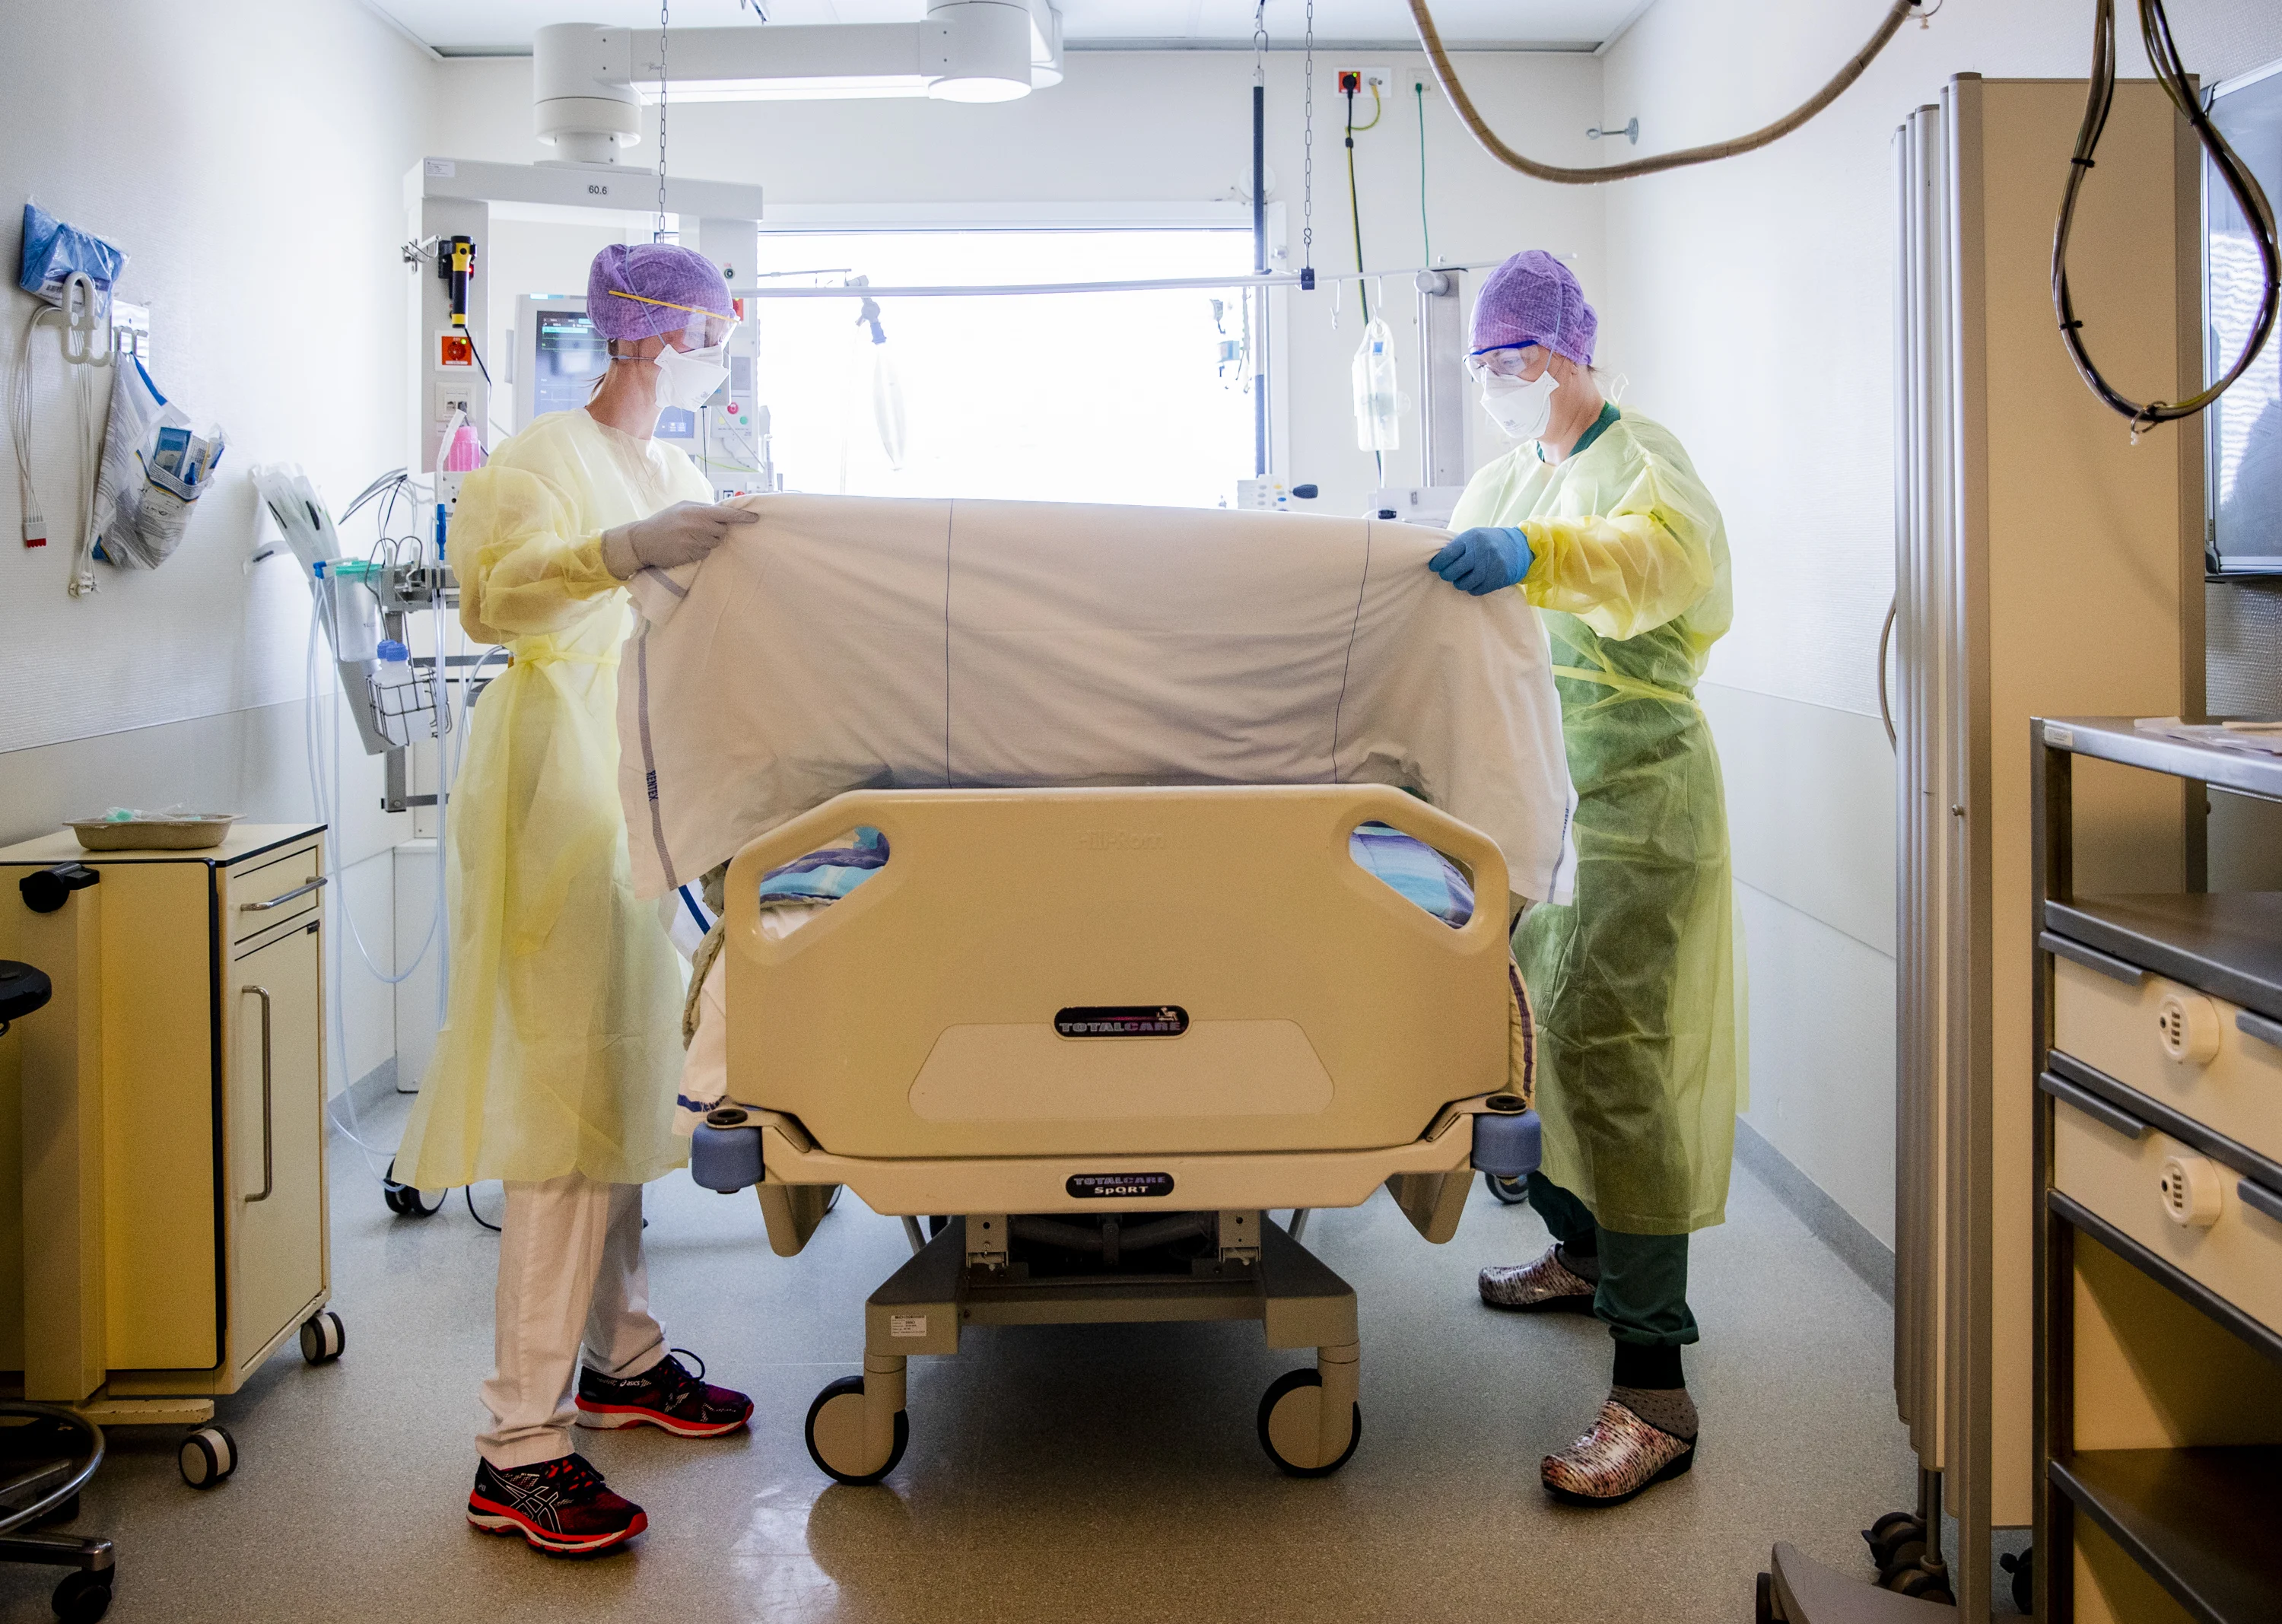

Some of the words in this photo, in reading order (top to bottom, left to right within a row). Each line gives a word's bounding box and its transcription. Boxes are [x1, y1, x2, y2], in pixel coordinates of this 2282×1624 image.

[589, 185, 607, 195] 60.6
[646, 770, 659, 802] RENTEX
[1059, 1021, 1181, 1032] TOTALCARE
[1074, 1177, 1166, 1185] TOTALCARE
